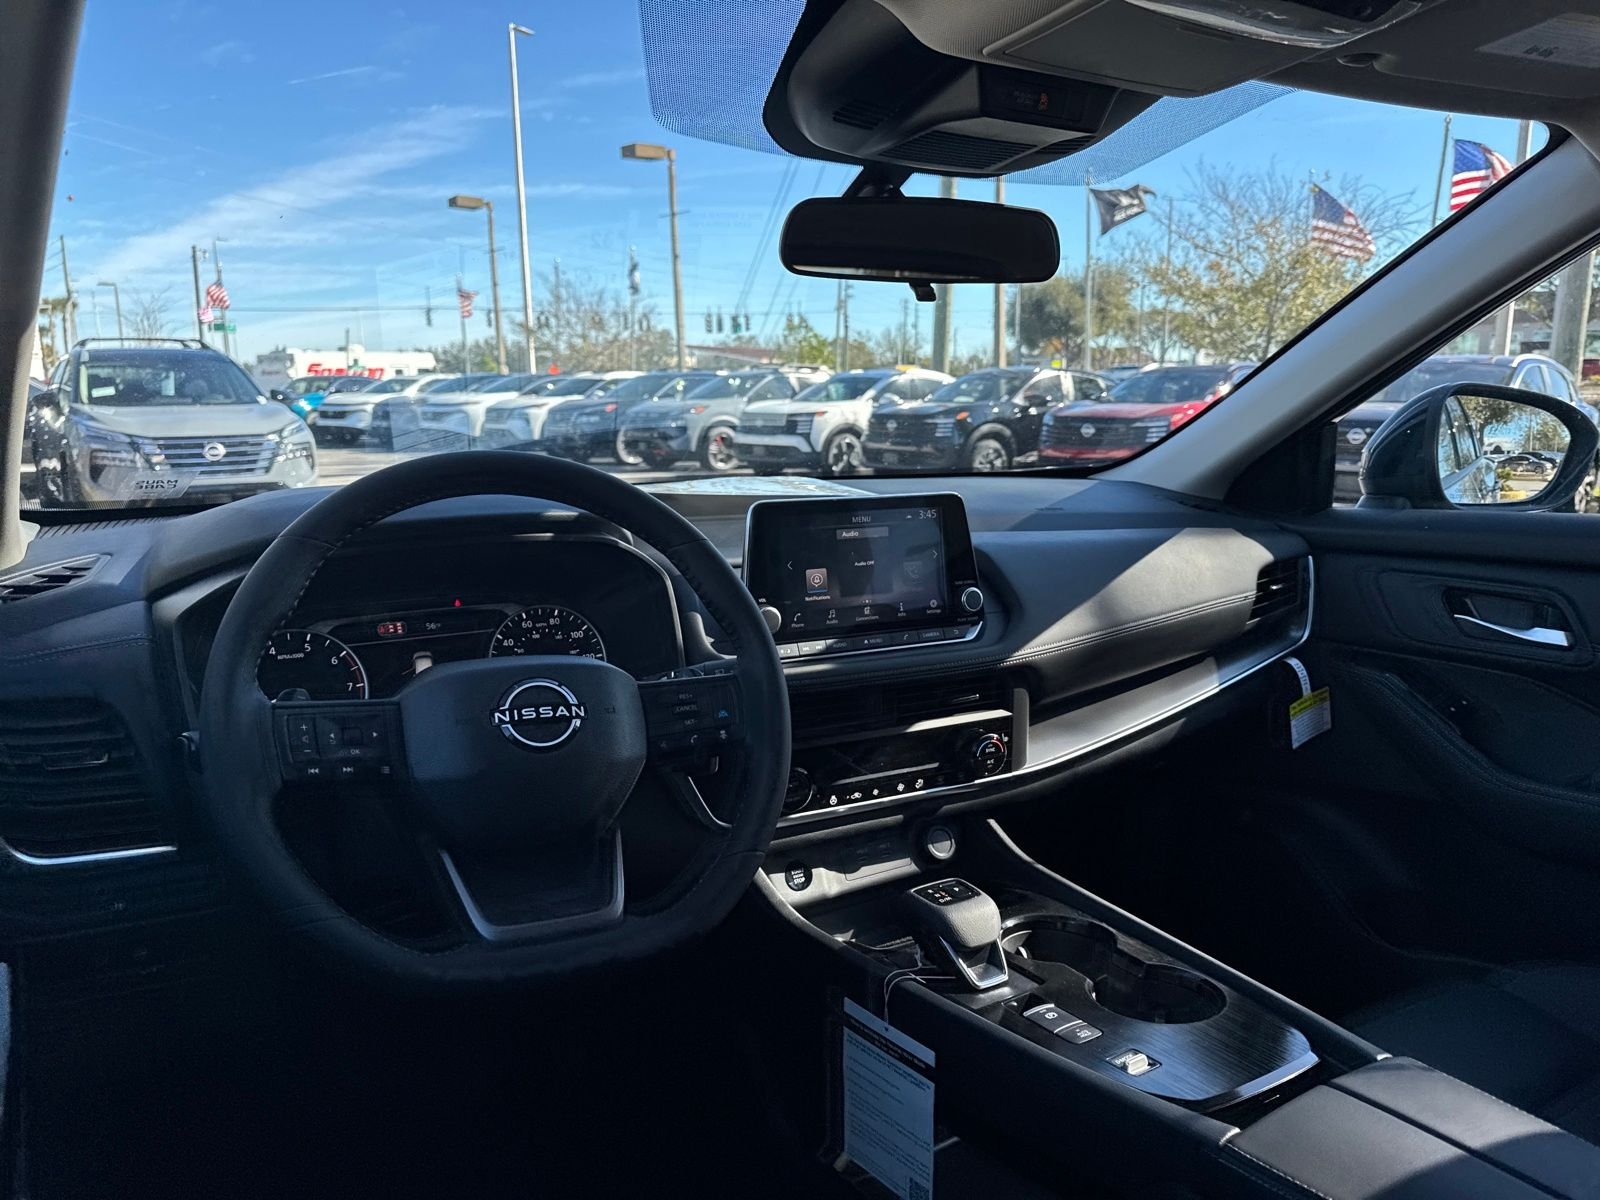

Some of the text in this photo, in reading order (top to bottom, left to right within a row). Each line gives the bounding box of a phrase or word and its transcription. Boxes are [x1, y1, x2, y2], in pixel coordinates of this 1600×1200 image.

[919, 509, 937, 519] 3:45
[852, 515, 871, 523] MENU
[521, 620, 533, 628] 60
[549, 617, 560, 625] 80
[570, 630, 584, 638] 100
[502, 638, 514, 647] 40
[269, 647, 276, 655] 4
[304, 644, 311, 652] 5
[331, 657, 338, 665] 6
[346, 682, 353, 691] 7
[676, 704, 698, 712] CANCEL
[494, 705, 585, 724] NISSAN
[793, 876, 806, 885] STOP
